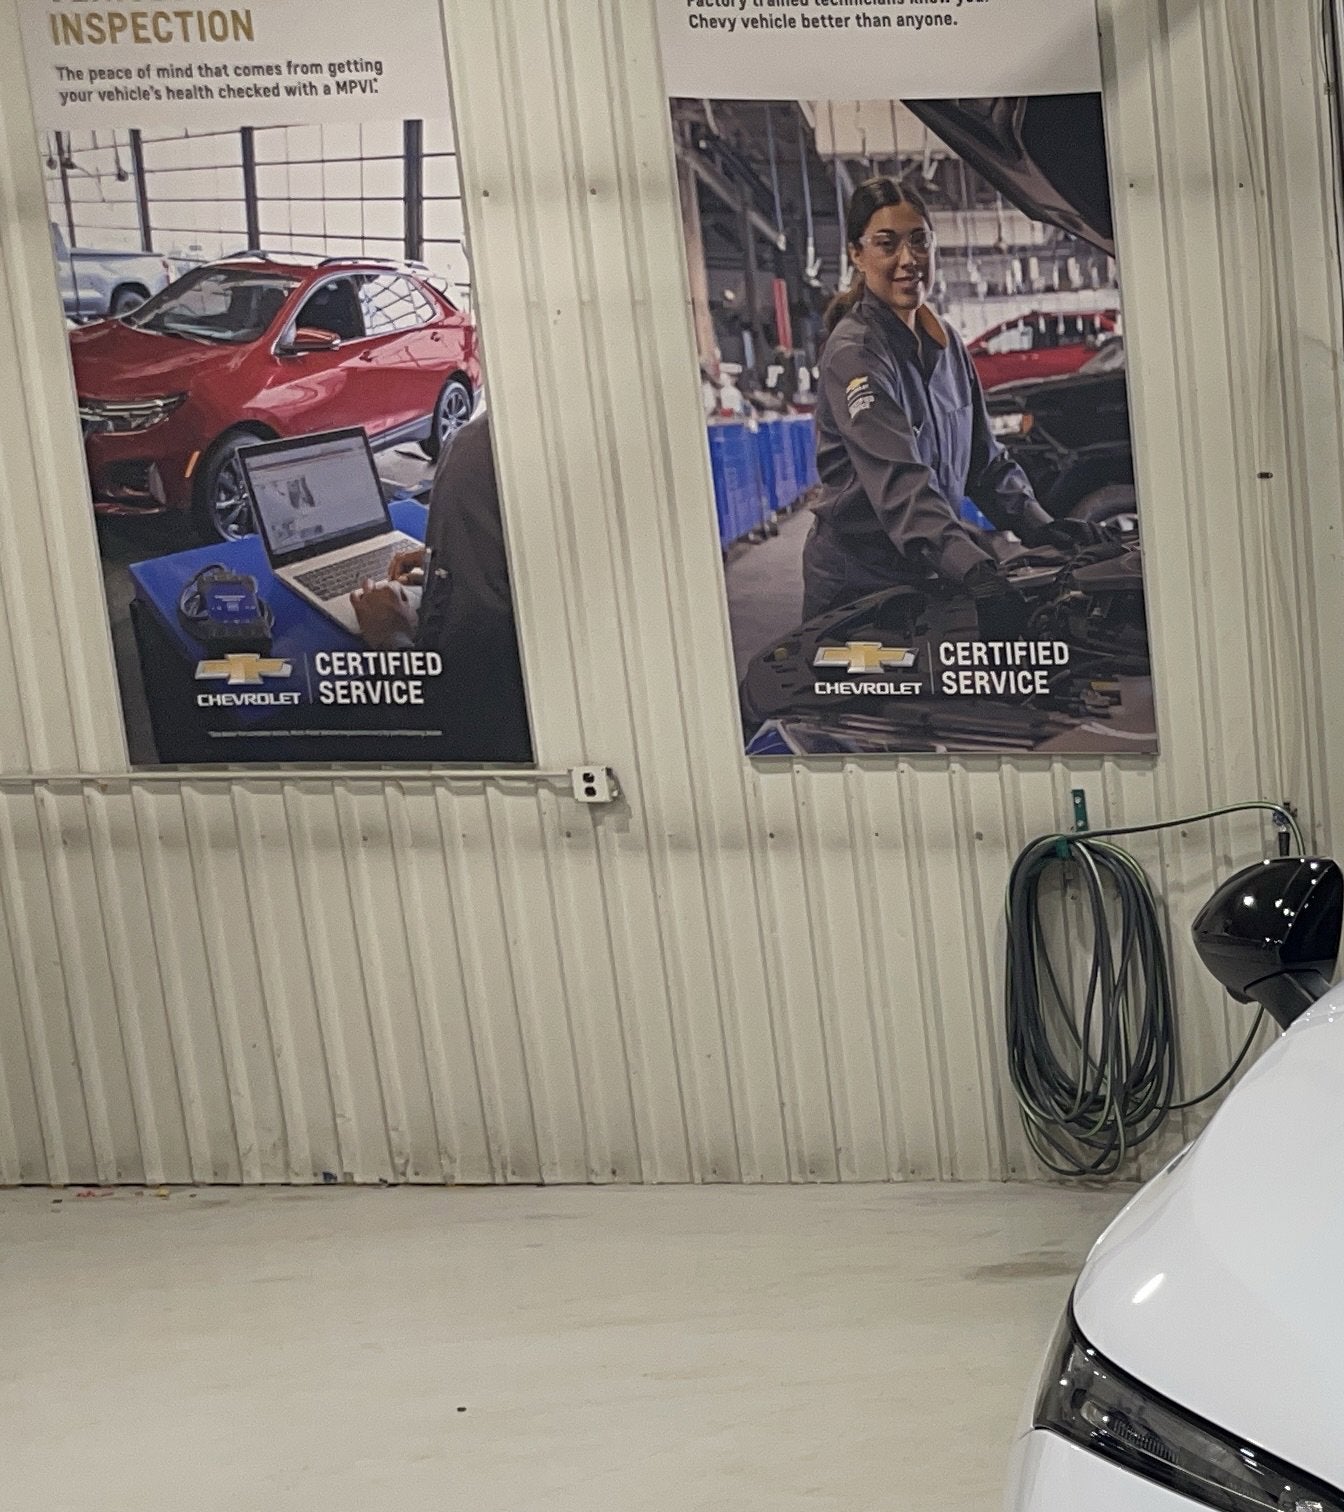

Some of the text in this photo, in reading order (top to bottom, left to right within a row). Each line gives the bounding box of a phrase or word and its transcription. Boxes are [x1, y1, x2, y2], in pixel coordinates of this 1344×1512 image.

[50, 9, 254, 46] INSPECTION
[688, 12, 958, 32] Chevy vehicle better than anyone.
[56, 58, 383, 84] The peace of mind that comes from getting
[59, 90, 93, 107] your
[98, 85, 162, 102] vehicle's
[166, 84, 214, 100] health
[218, 83, 280, 99] checked
[284, 81, 318, 97] with
[322, 84, 331, 96] a
[314, 651, 443, 677] CERTIFIED
[938, 640, 1070, 667] CERTIFIED
[318, 680, 425, 705] SERVICE
[813, 681, 923, 697] CHEVROLET
[941, 670, 1050, 696] SERVICE
[196, 691, 301, 708] CHEVROLET
